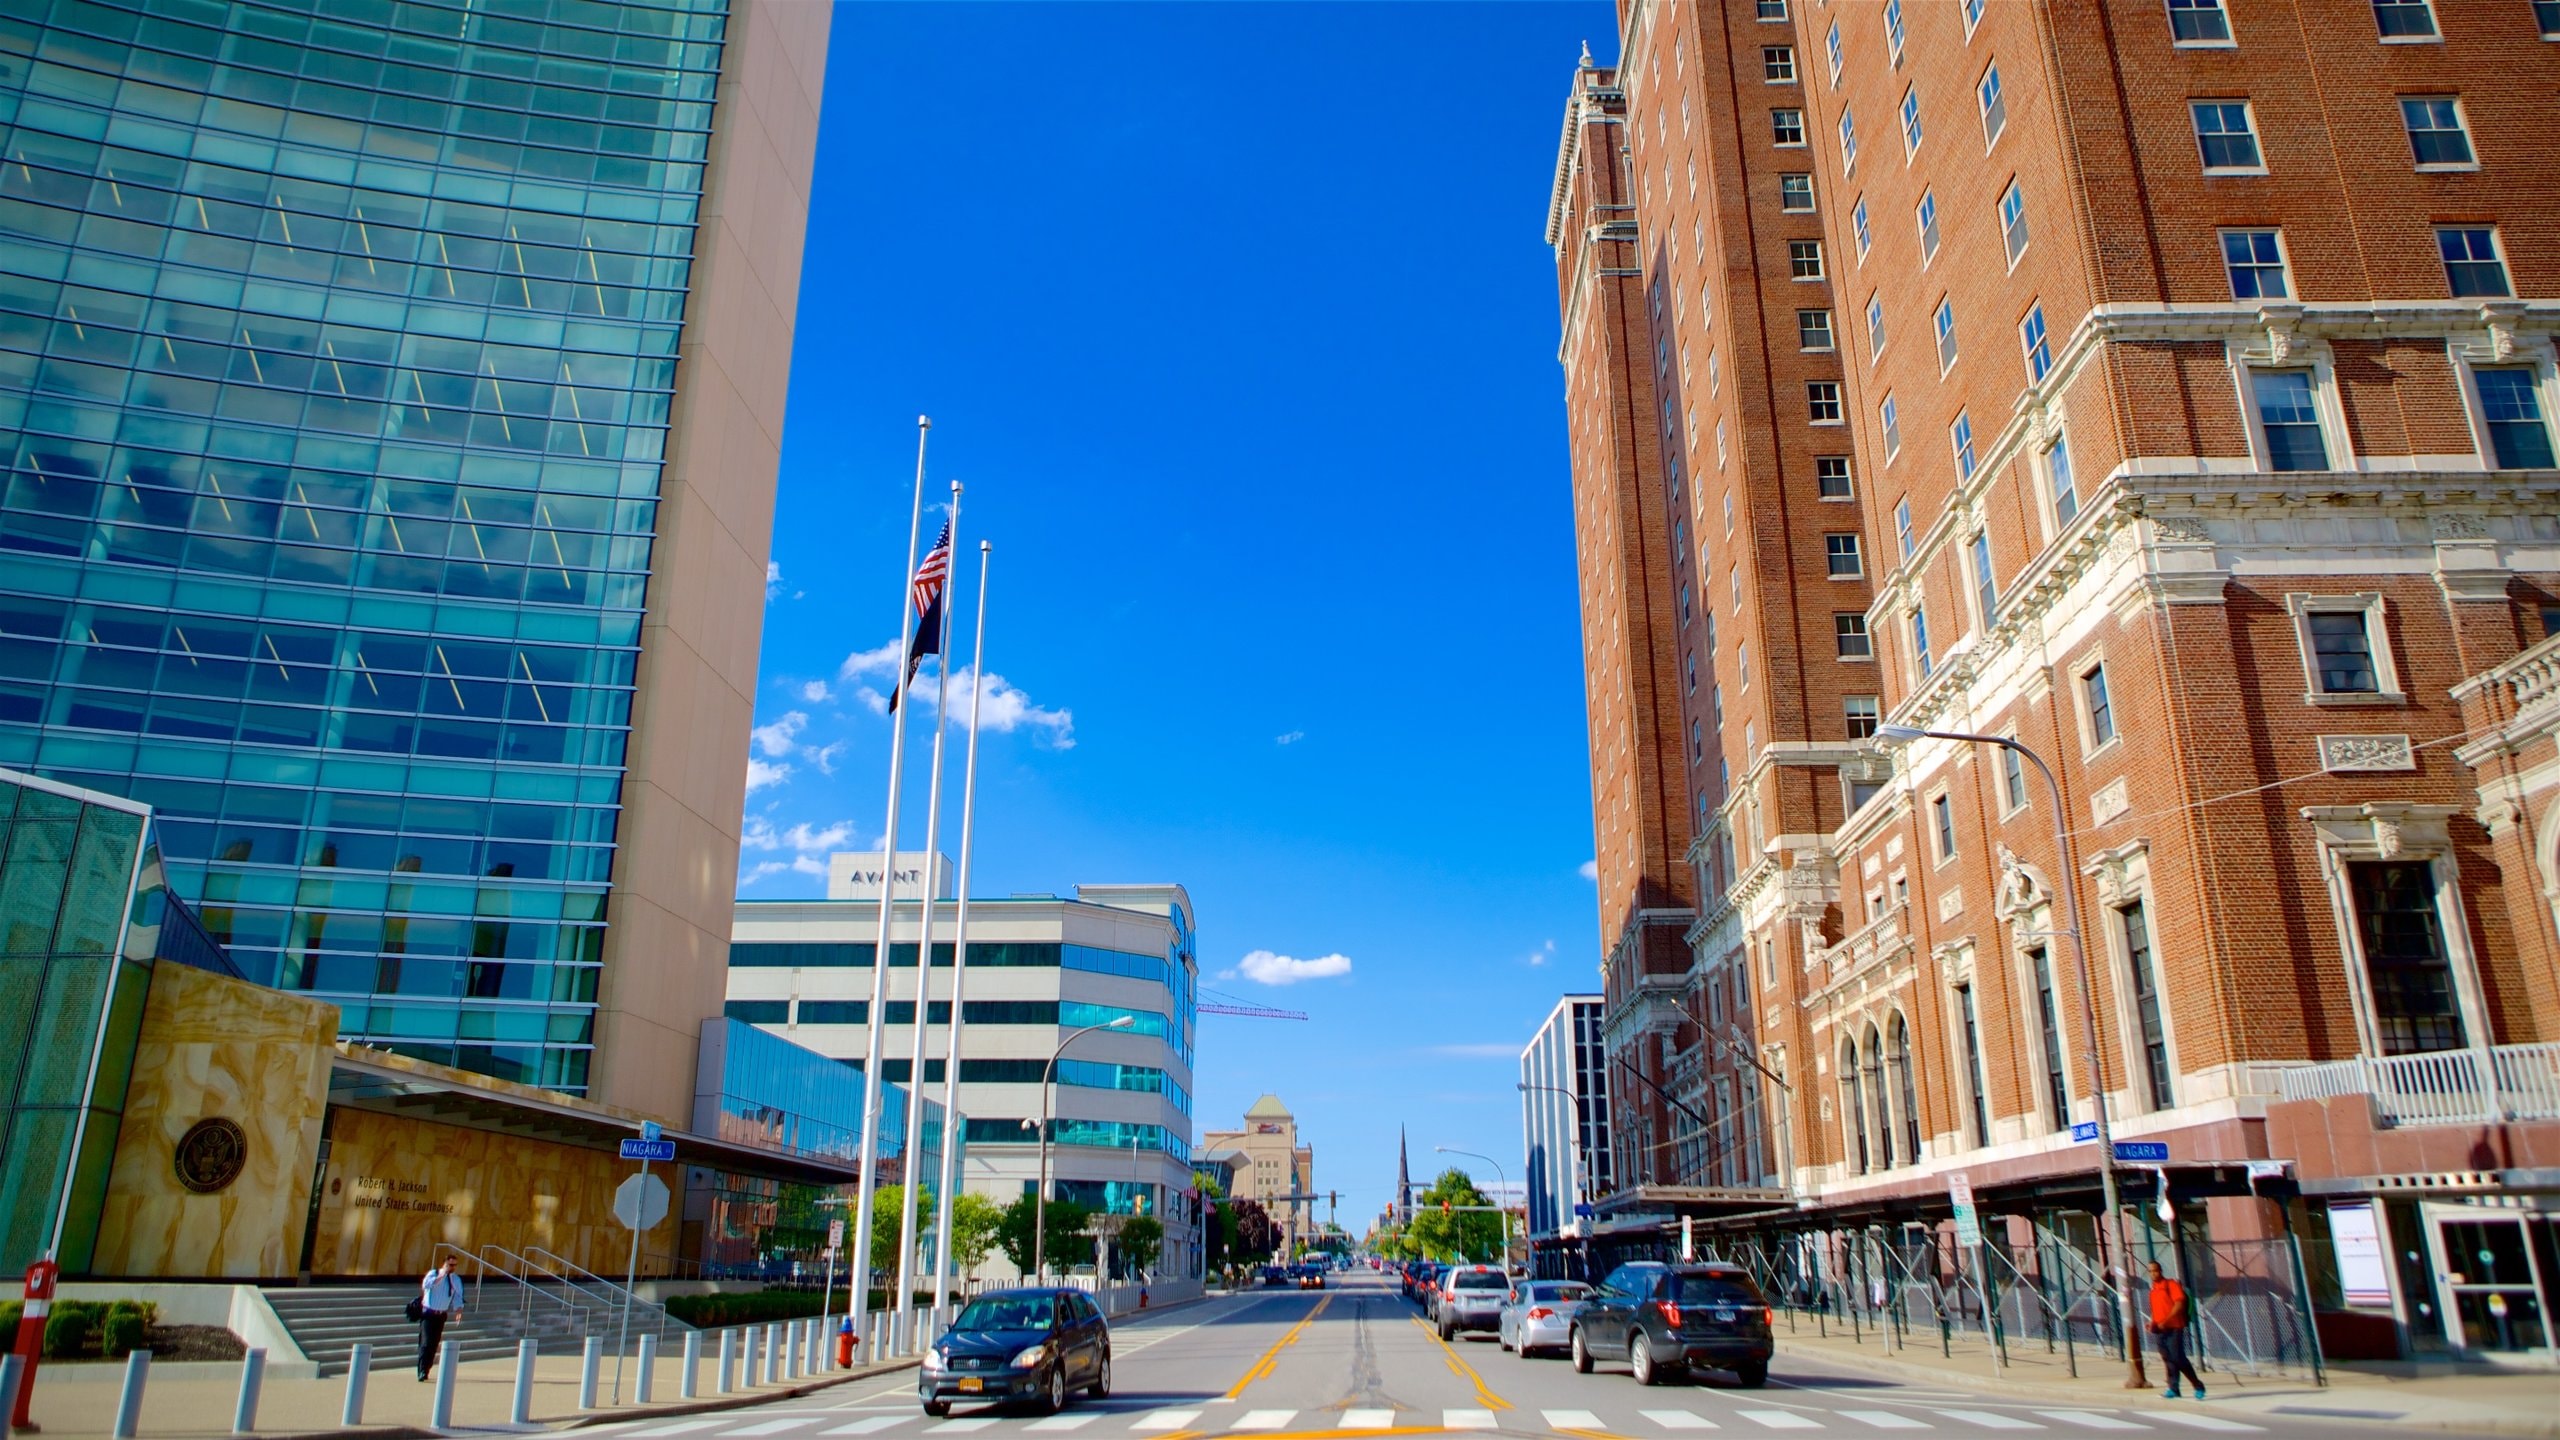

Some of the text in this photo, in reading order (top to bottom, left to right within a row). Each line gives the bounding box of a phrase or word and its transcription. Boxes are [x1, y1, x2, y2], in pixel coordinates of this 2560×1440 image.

[622, 1143, 662, 1156] NIAGARA
[2114, 1144, 2157, 1158] NIAGARA
[358, 1176, 385, 1190] Robert
[398, 1180, 428, 1193] Jackson
[355, 1195, 454, 1214] United States Courthouse
